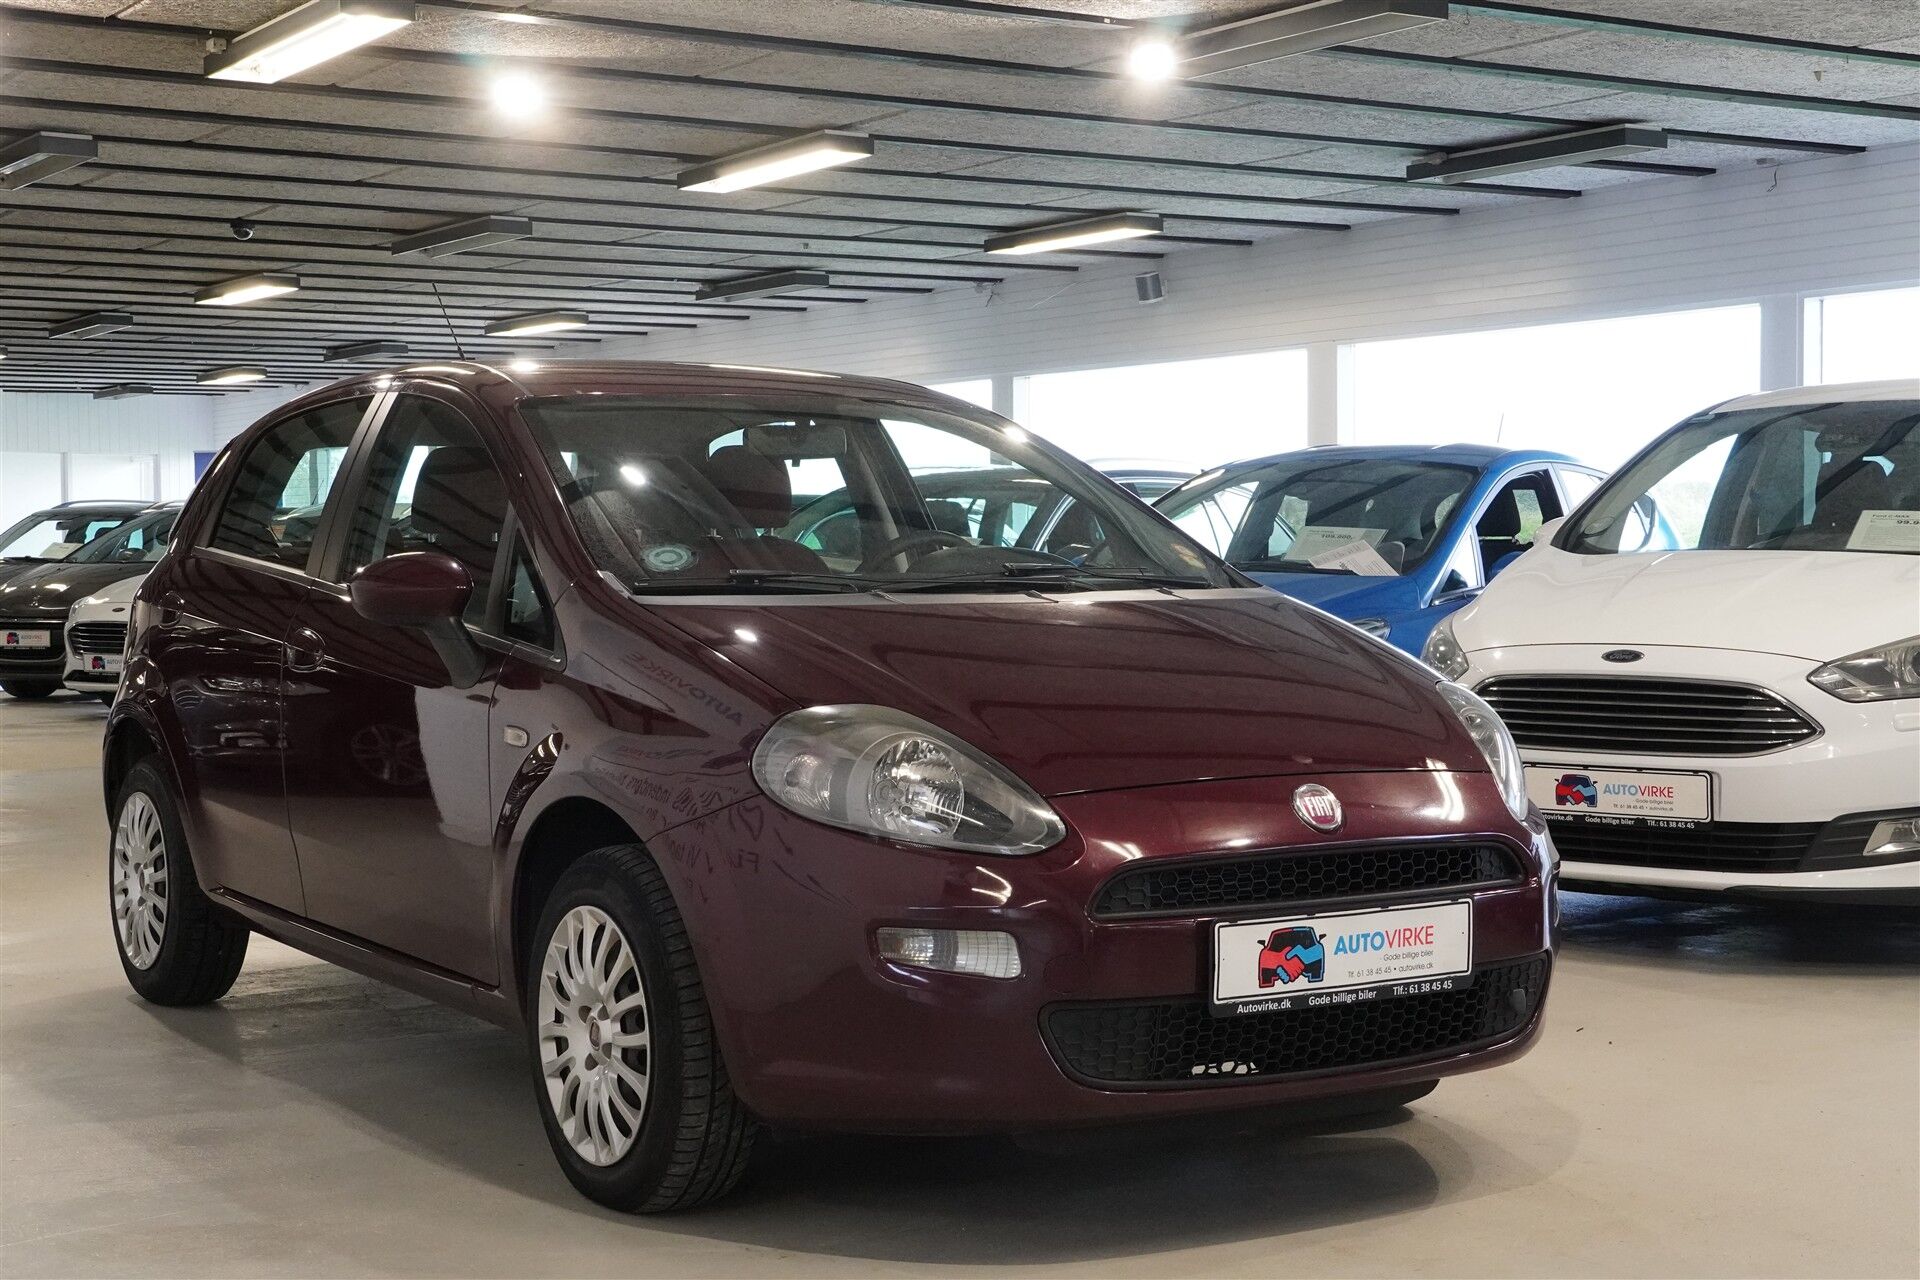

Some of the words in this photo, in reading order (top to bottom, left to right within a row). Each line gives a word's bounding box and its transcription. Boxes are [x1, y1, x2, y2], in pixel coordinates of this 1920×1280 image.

[1603, 783, 1674, 799] AUTOVIRKE
[1303, 795, 1333, 817] FIAT
[1543, 814, 1574, 822] tovirke.dk
[1585, 816, 1601, 824] Gode
[1602, 817, 1620, 826] billige
[1620, 818, 1635, 826] biler
[1334, 925, 1434, 956] AUTOVIRKE
[1383, 952, 1401, 962] Gode
[1402, 950, 1420, 961] billige
[1420, 949, 1434, 958] biler
[1356, 969, 1364, 978] 61
[1366, 968, 1374, 977] 38
[1375, 967, 1383, 976] 45
[1384, 966, 1392, 975] 45
[1398, 962, 1434, 973] autovirke.dk
[1237, 1000, 1292, 1014] Autovirke.dk
[1308, 994, 1331, 1006] Gode
[1332, 991, 1357, 1004] billige
[1358, 989, 1377, 1001] biler
[1392, 986, 1408, 996] Tlf.:
[1409, 985, 1419, 994] 61
[1420, 983, 1430, 993] 38
[1431, 981, 1442, 991] 45
[1442, 980, 1453, 990] 45
